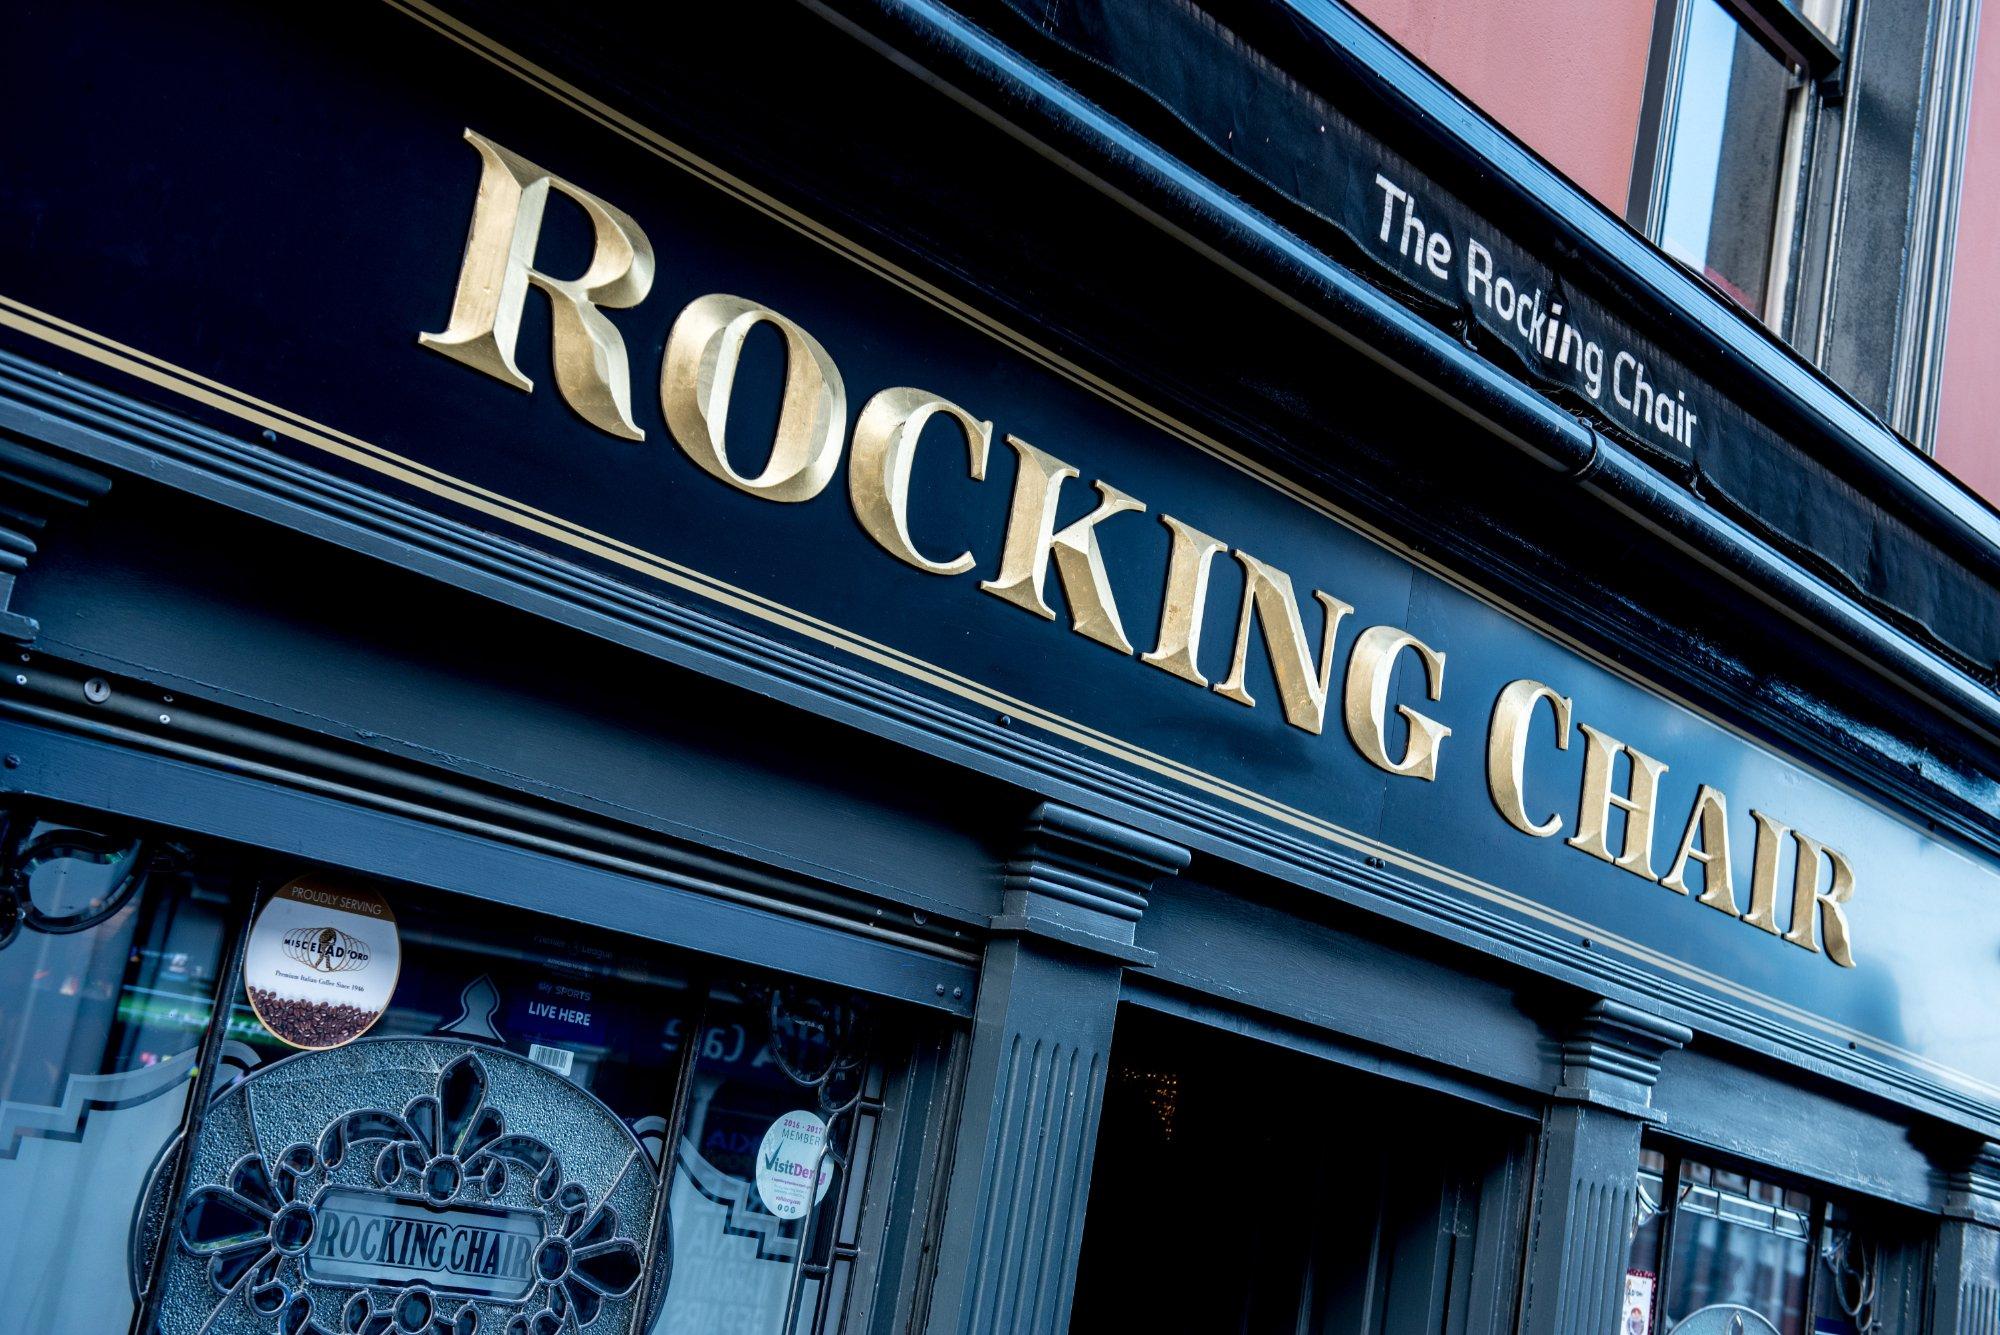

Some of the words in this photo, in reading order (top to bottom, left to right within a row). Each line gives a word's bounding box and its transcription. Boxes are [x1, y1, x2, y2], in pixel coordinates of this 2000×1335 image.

[1376, 174, 1452, 280] The
[1467, 238, 1603, 399] Rocking
[1612, 350, 1697, 448] Chair
[419, 127, 1452, 782] ROCKING
[1488, 679, 1857, 968] CHAIR
[291, 886, 339, 905] PROUDLY
[340, 897, 382, 915] SERVING
[274, 969, 300, 981] Premium
[300, 974, 318, 984] Italian
[318, 978, 335, 987] Coffee
[336, 981, 351, 990] Since
[555, 985, 592, 1001] SPORTS
[528, 1001, 558, 1019] LIVE
[558, 1007, 592, 1026] HERE
[782, 1128, 821, 1146] MEMBER
[783, 1119, 800, 1129] 2016
[806, 1124, 823, 1135] 2017
